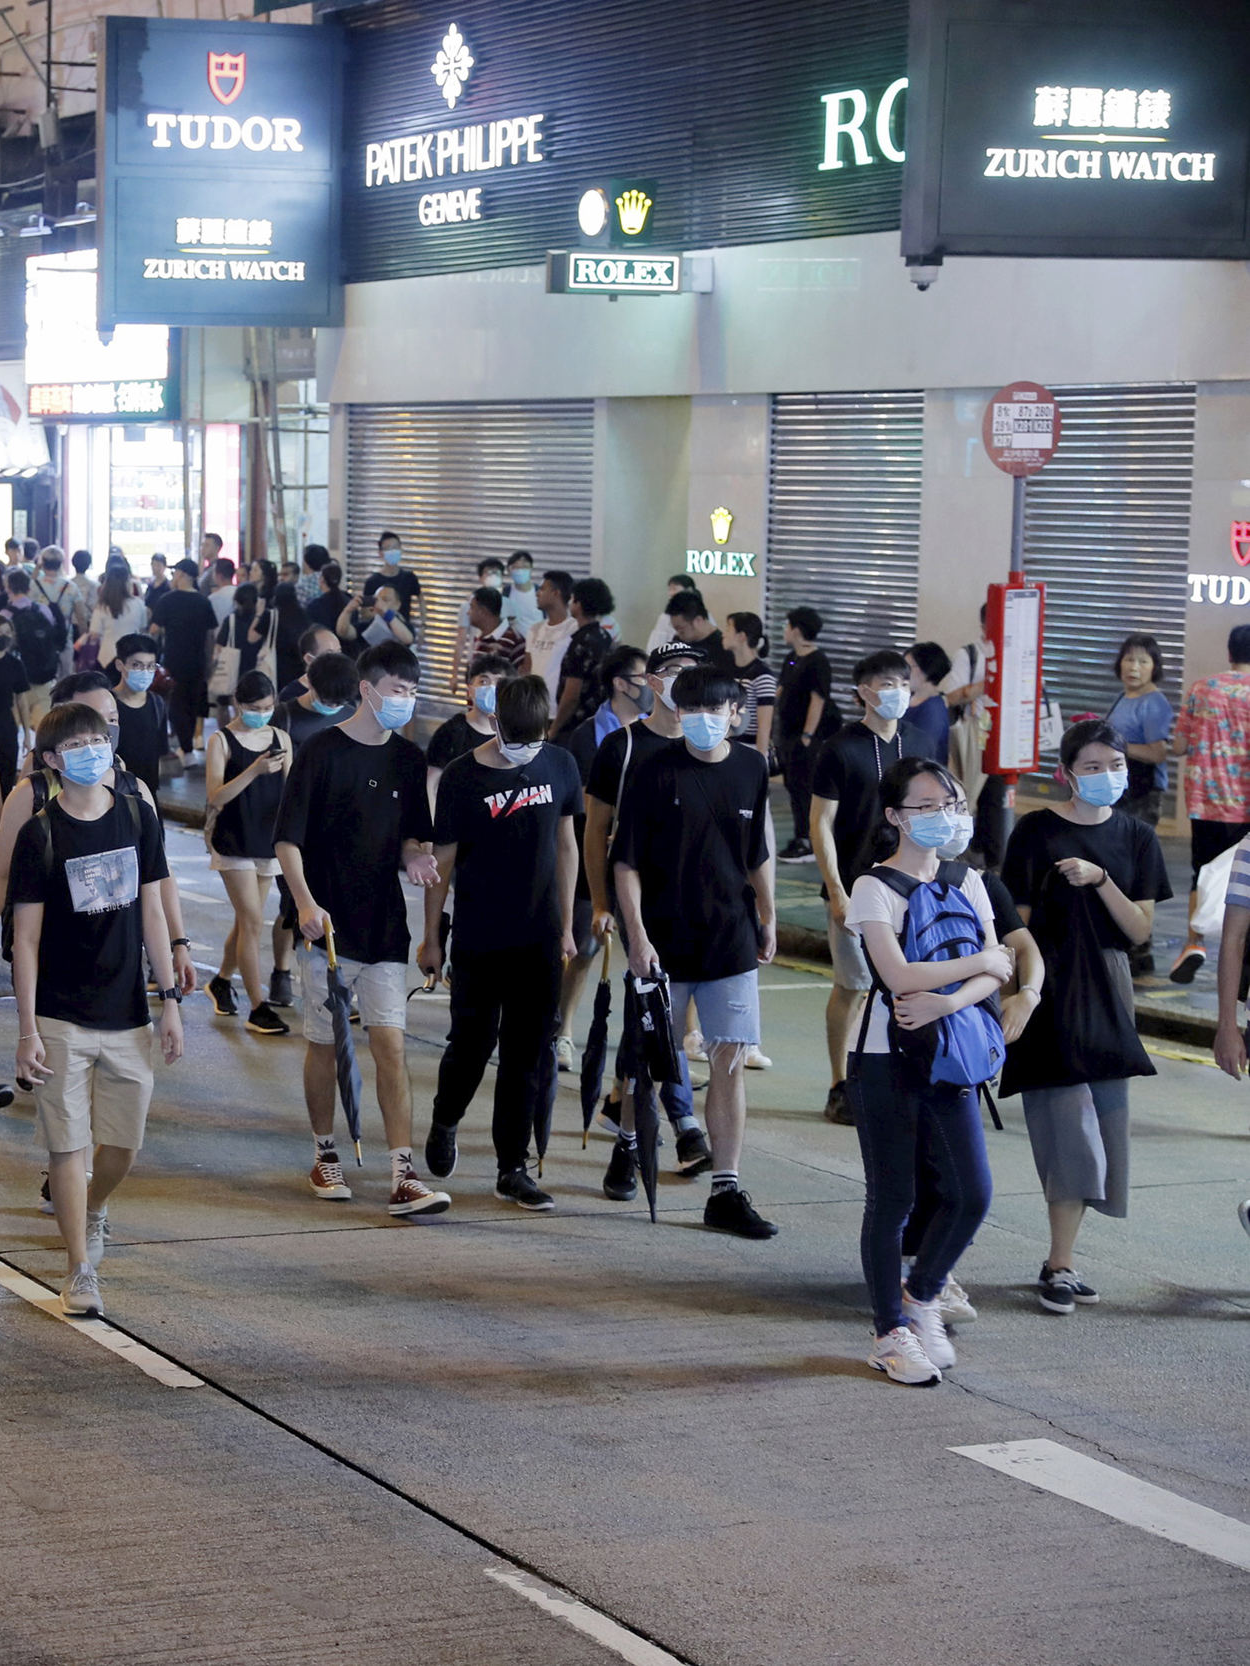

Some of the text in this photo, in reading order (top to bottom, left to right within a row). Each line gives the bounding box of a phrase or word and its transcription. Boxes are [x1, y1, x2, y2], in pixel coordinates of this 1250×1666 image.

[147, 113, 304, 152] TUDOR
[365, 113, 545, 188] PATEK PHILIPPE
[983, 148, 1216, 182] ZURICH WATCH
[418, 187, 482, 226] GENEVE
[143, 258, 306, 282] ZURICH WATCH
[575, 259, 673, 285] ROLEX
[685, 549, 757, 577] ROLEX
[1187, 573, 1250, 606] TUD
